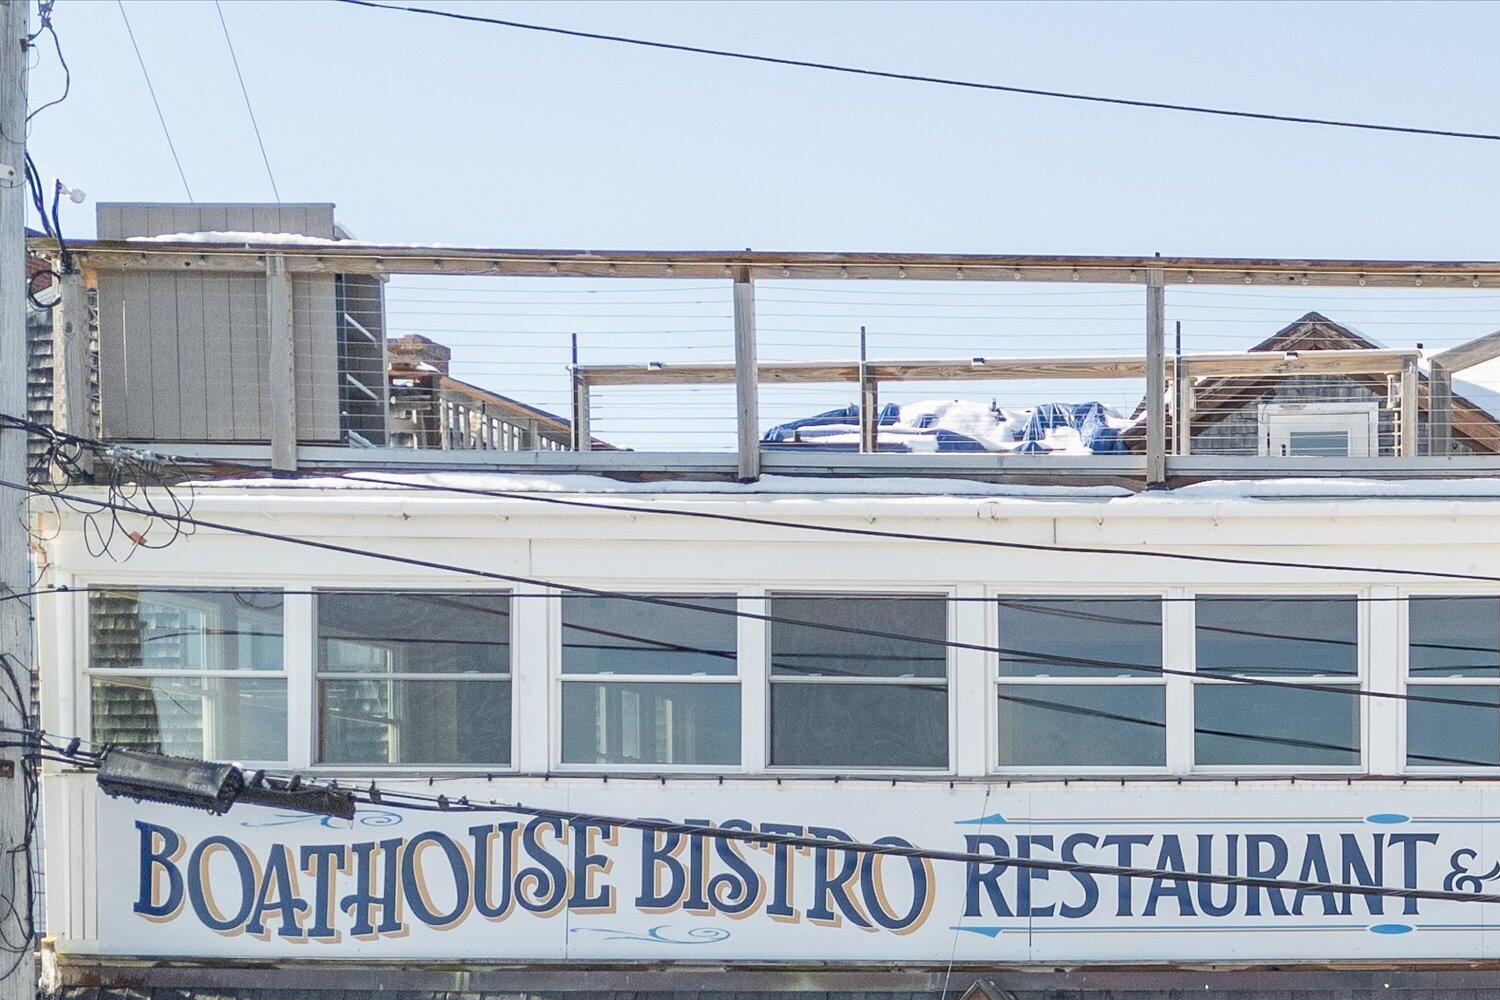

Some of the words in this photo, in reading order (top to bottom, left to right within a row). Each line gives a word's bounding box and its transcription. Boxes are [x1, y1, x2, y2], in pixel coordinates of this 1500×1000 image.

[133, 815, 617, 943] BOATHOUSE
[634, 817, 937, 936] BISTRO
[963, 831, 1440, 920] RESTAURANT
